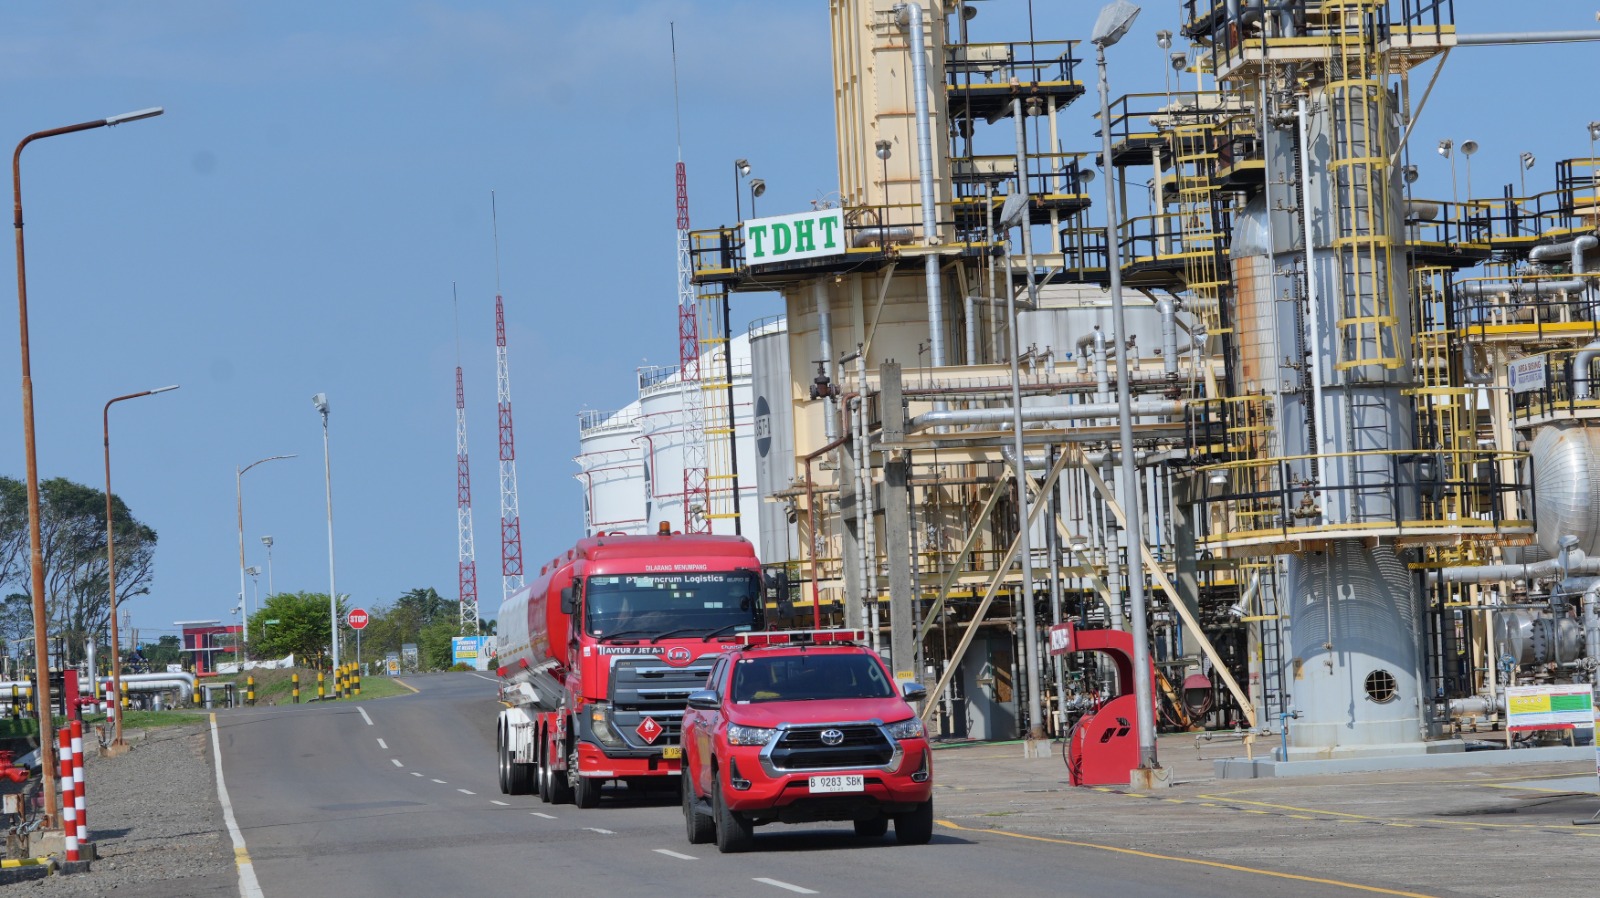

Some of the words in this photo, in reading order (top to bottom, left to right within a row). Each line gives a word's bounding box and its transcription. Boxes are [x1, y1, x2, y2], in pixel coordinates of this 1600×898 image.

[749, 216, 838, 257] TDHT
[643, 576, 682, 584] Syncrum
[684, 575, 724, 584] Logistics
[350, 615, 366, 623] STOP
[810, 778, 816, 787] B
[820, 777, 842, 787] 9283
[846, 776, 862, 786] SBK
